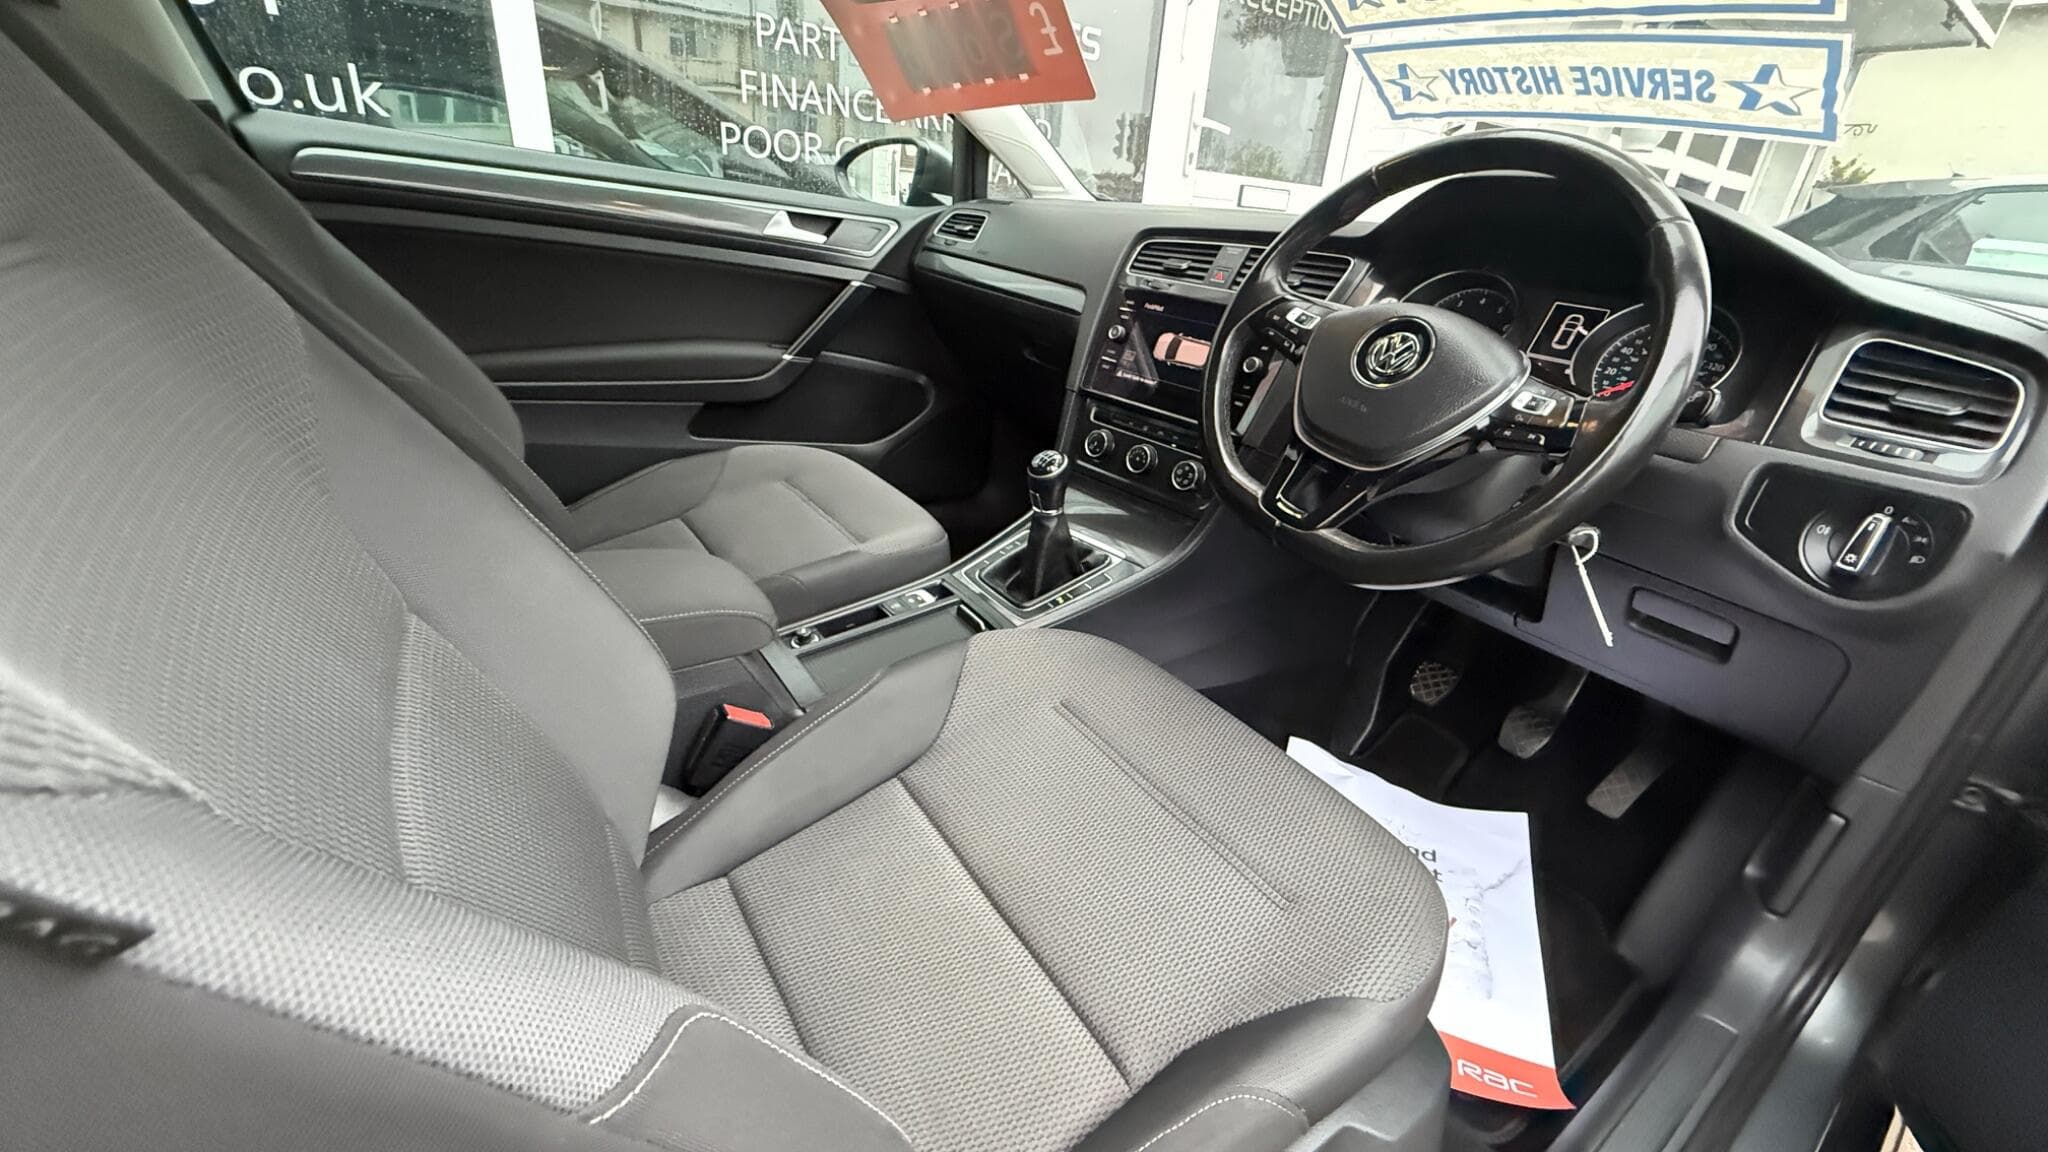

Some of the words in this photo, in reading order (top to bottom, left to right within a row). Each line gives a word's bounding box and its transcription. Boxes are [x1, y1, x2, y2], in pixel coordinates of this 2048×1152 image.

[756, 12, 841, 61] PART
[238, 62, 391, 117] o.uk
[720, 121, 827, 164] POOR
